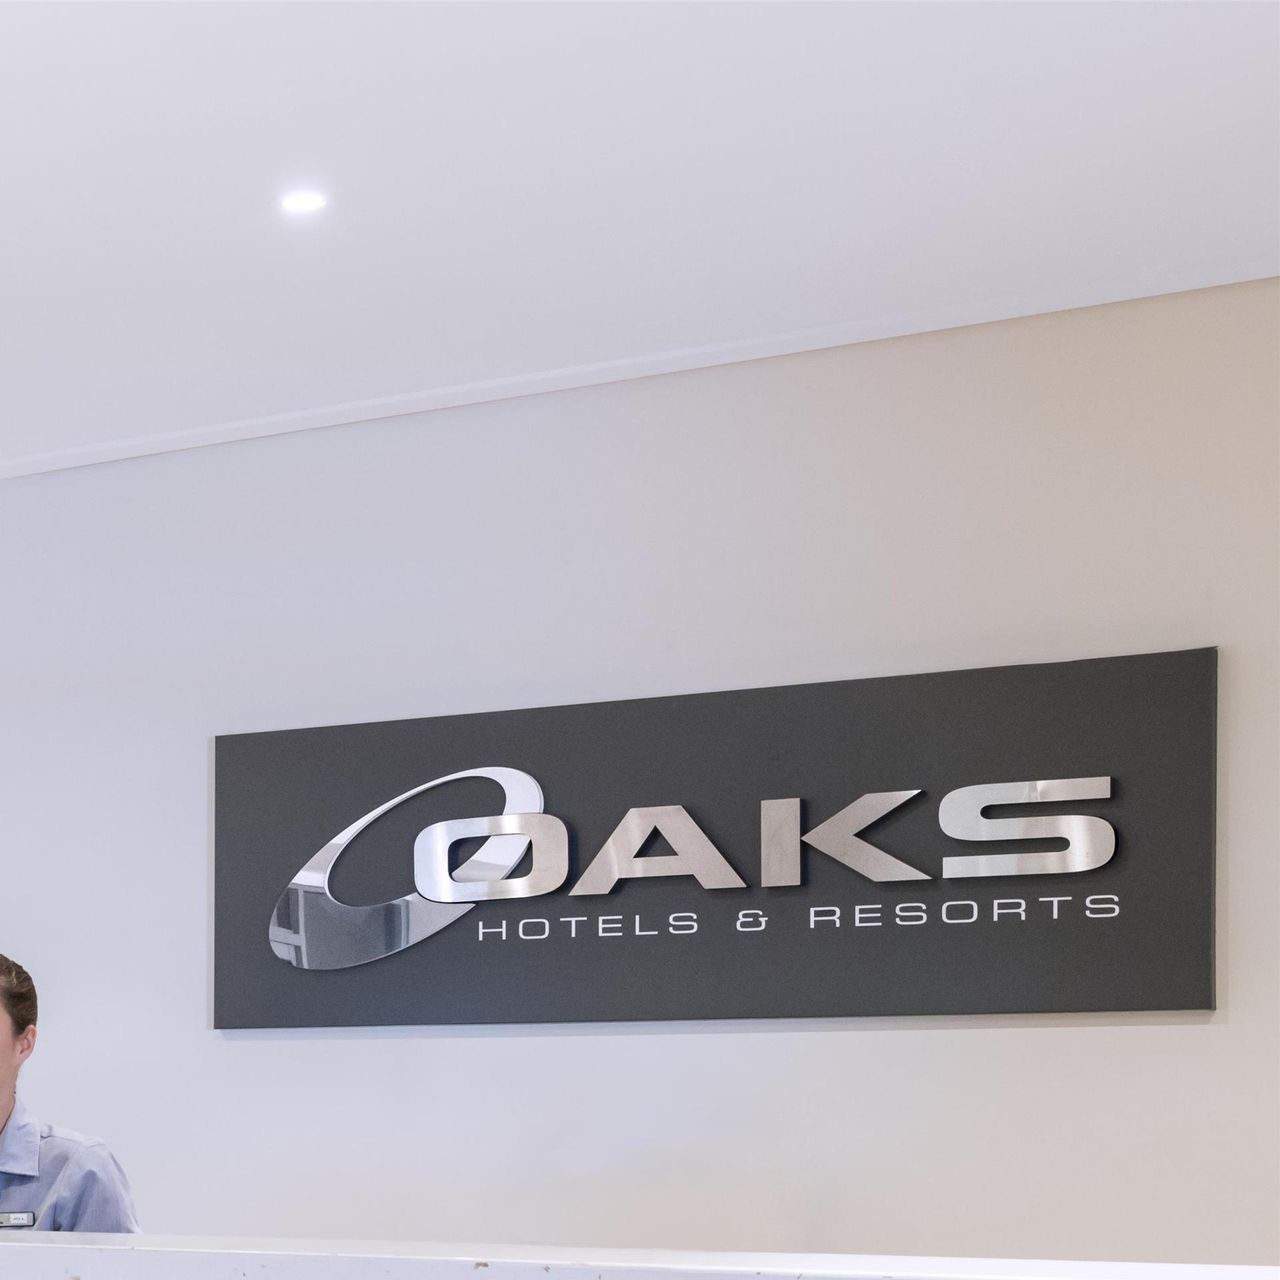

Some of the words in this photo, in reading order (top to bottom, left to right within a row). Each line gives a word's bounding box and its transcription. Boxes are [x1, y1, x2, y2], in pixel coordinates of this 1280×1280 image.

[414, 776, 1116, 903] OAKS
[477, 911, 699, 942] HOTELS
[735, 909, 769, 932] &
[808, 893, 1121, 930] RESORTS
